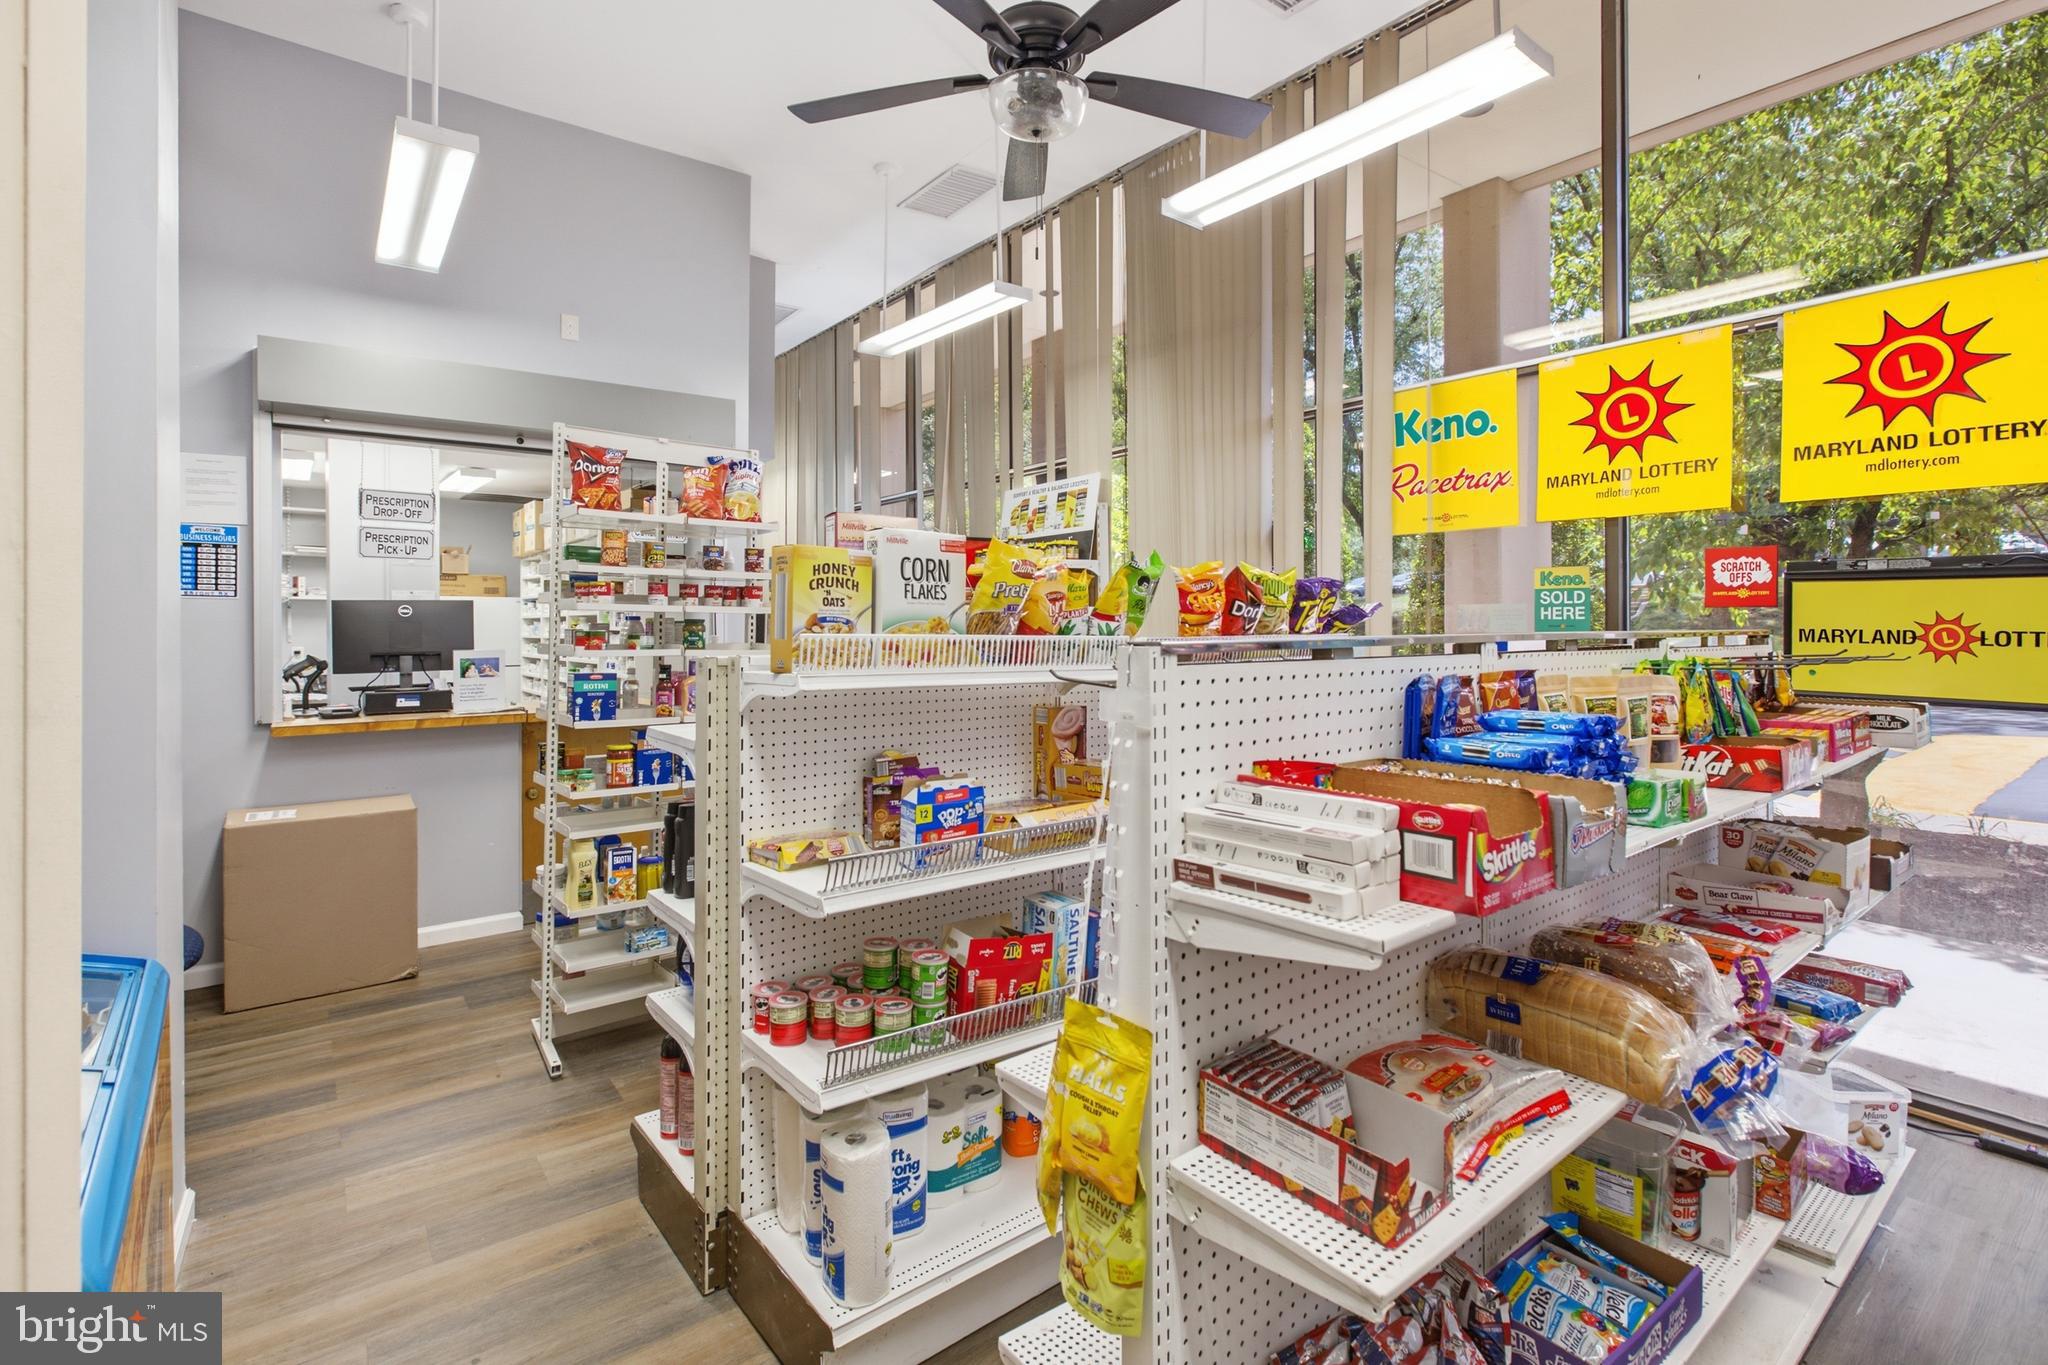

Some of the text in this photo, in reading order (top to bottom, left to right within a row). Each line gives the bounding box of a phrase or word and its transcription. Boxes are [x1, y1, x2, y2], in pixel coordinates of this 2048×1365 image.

[1899, 354, 1928, 383] L
[1618, 402, 1640, 428] L
[1793, 418, 2047, 462] MARYLAND LOTTERY
[1865, 453, 1961, 473] mdlottery.com
[1546, 457, 1719, 490] MARYLAND LOTTERY
[1392, 463, 1513, 503] Racetrax
[1595, 484, 1660, 500] mdlottery.com
[365, 494, 430, 509] PRESCRIPTION
[212, 534, 236, 542] HOURS
[365, 532, 429, 545] PRESCRIPTION
[812, 562, 856, 578] HONEY
[900, 556, 950, 583] CORN
[1720, 561, 1762, 573] SCRATCH
[809, 576, 860, 593] CRUNCH
[1729, 572, 1753, 583] OFFS
[904, 583, 947, 601] FLAKES
[1540, 590, 1586, 605] SOLD
[822, 597, 846, 607] OATS
[1540, 606, 1586, 620] HERE
[1798, 628, 1917, 645] MARYLAND
[1980, 630, 2048, 648] LOTT
[1869, 720, 1902, 729] HOCOLATE
[1876, 714, 1891, 722] MILK
[919, 809, 929, 818] 12
[1725, 831, 1740, 840] 30
[1482, 838, 1537, 882] Skittles
[1777, 845, 1815, 869] Milano
[1708, 889, 1753, 901] Bear Claw
[1066, 908, 1080, 976] SALTINE
[1003, 943, 1023, 959] RITZ
[1489, 1006, 1516, 1019] WHITE
[1068, 1063, 1128, 1105] HALLS
[1069, 1089, 1090, 1103] COUGH
[1095, 1102, 1119, 1118] THROAT
[1861, 1111, 1888, 1120] Milano
[962, 1125, 990, 1151] Soft
[1077, 1187, 1119, 1225] CHEWS
